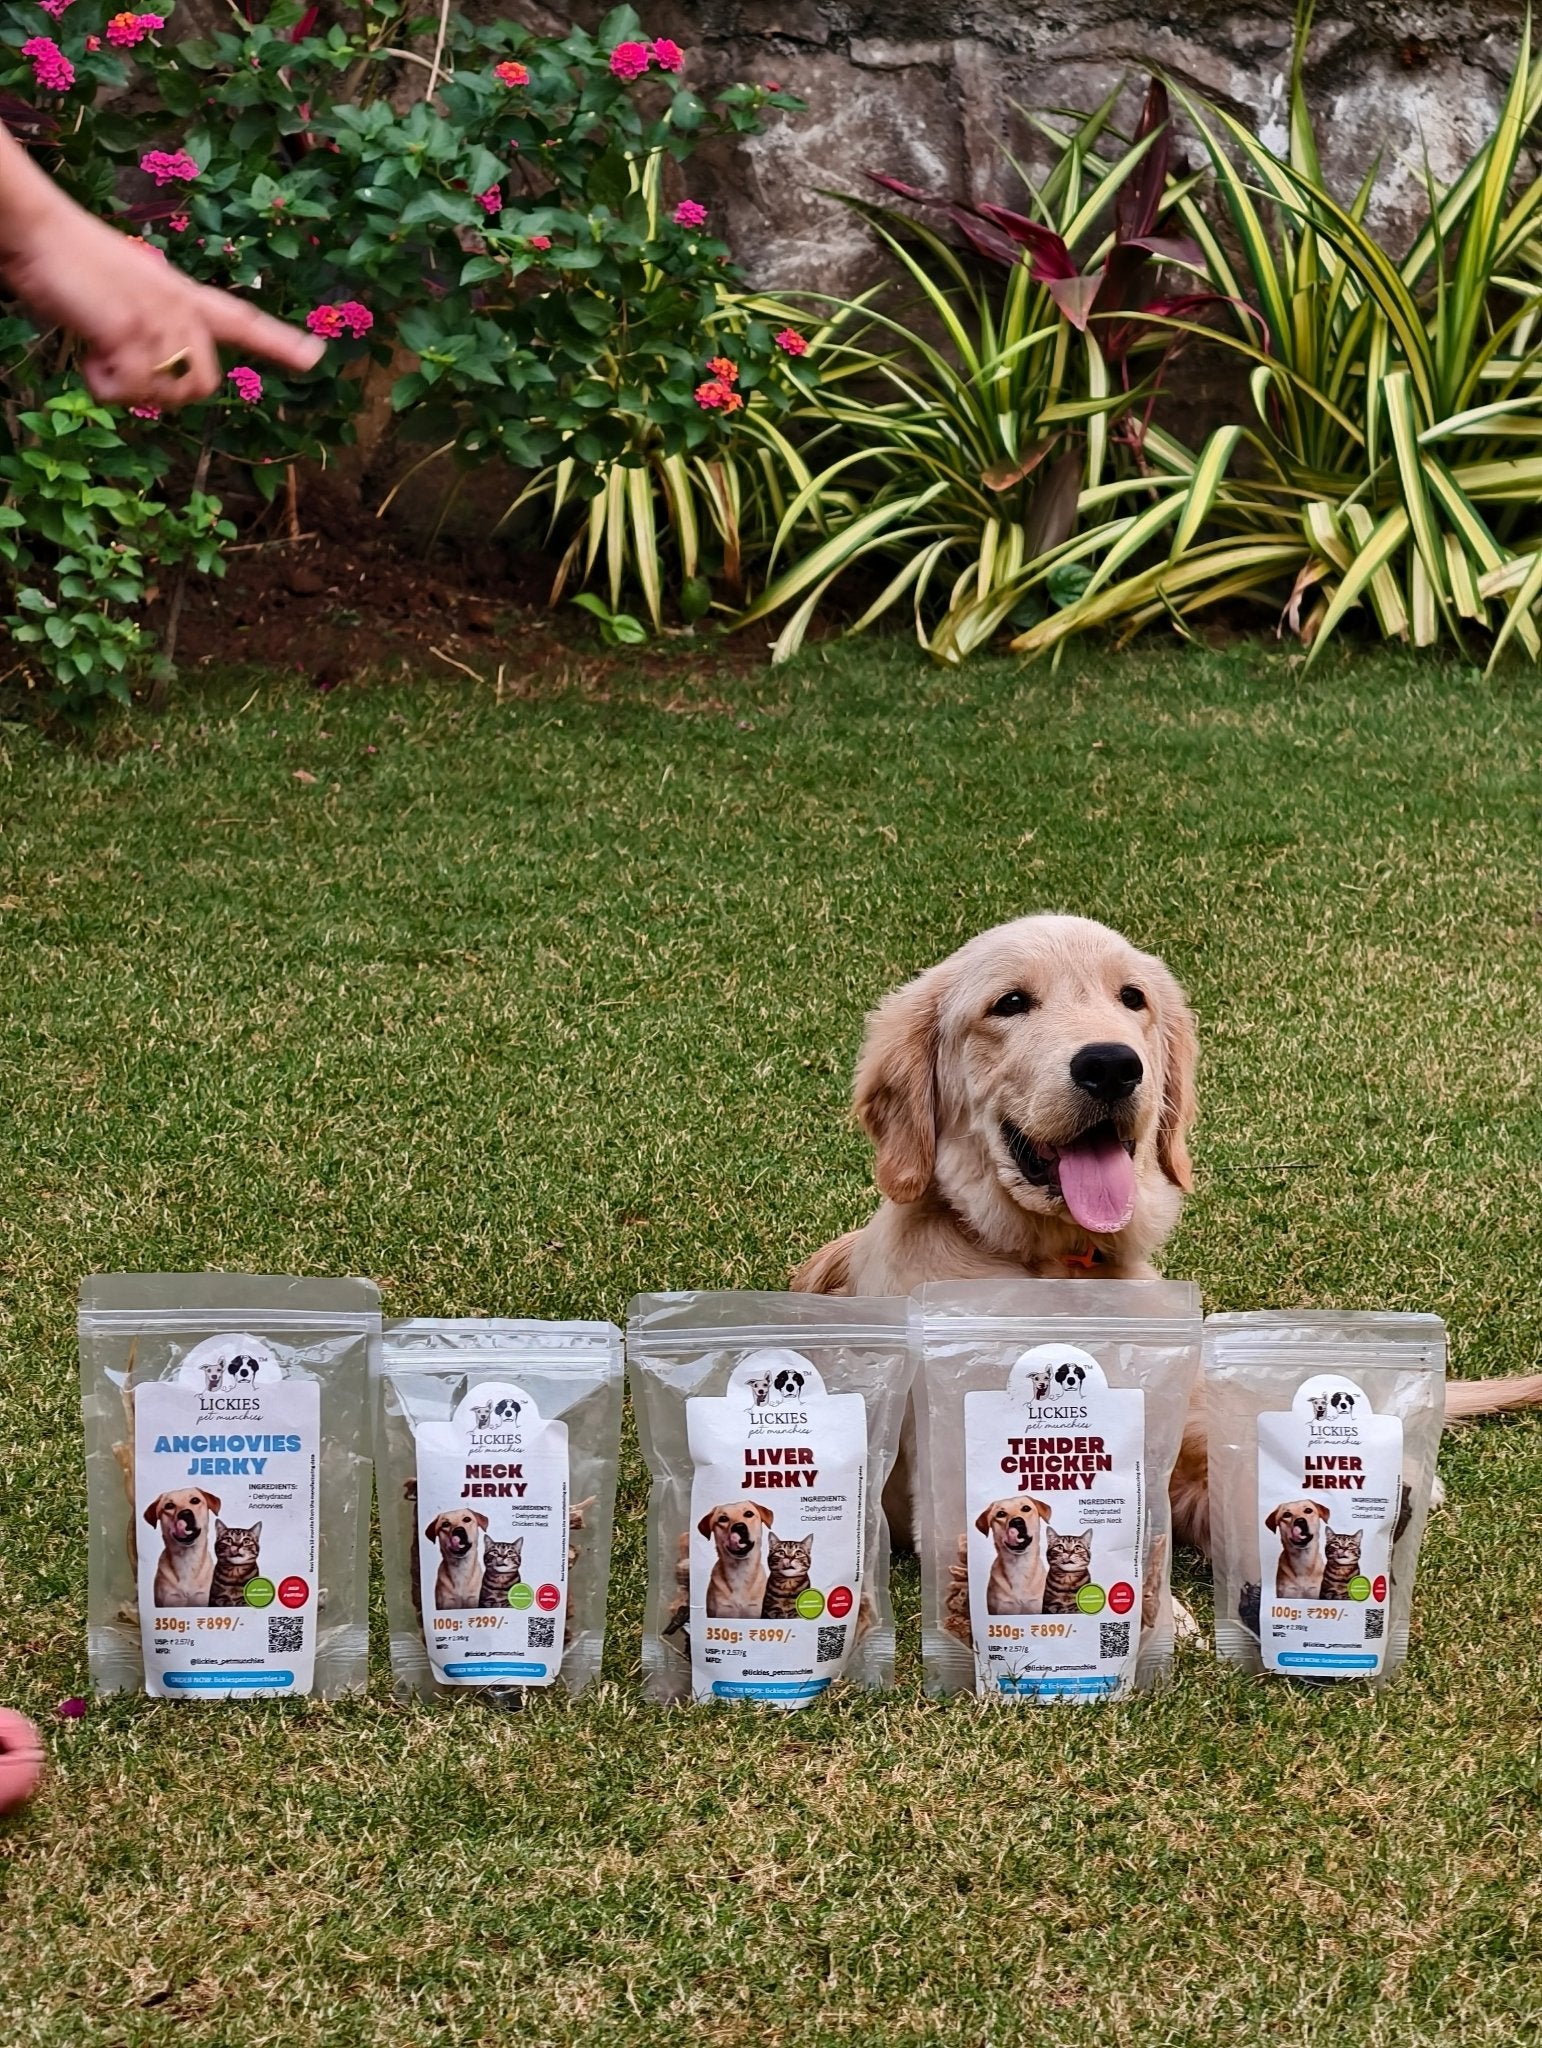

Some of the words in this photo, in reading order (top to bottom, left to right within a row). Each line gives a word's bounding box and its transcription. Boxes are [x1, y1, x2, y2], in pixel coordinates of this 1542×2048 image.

[200, 1398, 260, 1411] LICKIES
[196, 1411, 213, 1425] pet
[216, 1411, 263, 1421] munchies
[750, 1412, 808, 1425] LICKIES
[1029, 1406, 1087, 1419] LICKIES
[748, 1425, 766, 1438] pet
[767, 1425, 812, 1435] munchies
[1025, 1420, 1043, 1433] pet
[1045, 1419, 1092, 1429] munchies
[1311, 1426, 1358, 1436] LICKIES
[154, 1435, 302, 1453] ANCHOVIES
[471, 1434, 522, 1445] LICKIES
[1007, 1436, 1105, 1455] TENDER
[468, 1446, 484, 1456] pet
[744, 1447, 815, 1466] LIVER
[187, 1458, 268, 1475] JERKY
[1000, 1455, 1112, 1473] CHICKEN
[1305, 1456, 1362, 1470] LIVER
[466, 1464, 523, 1478] NECK
[741, 1470, 819, 1489] JERKY
[1018, 1473, 1096, 1491] JERKY
[1302, 1475, 1366, 1489] JERKY
[253, 1493, 292, 1501] Dehydrated
[460, 1483, 528, 1498] JERKY
[805, 1505, 842, 1513] Dehydrated
[1083, 1508, 1121, 1516] Dehydrated
[1272, 1607, 1301, 1620] 100g:
[155, 1617, 190, 1633] 350g:
[433, 1618, 463, 1631] 100g:
[706, 1627, 743, 1643] 350g:
[988, 1625, 1024, 1640] 350g:
